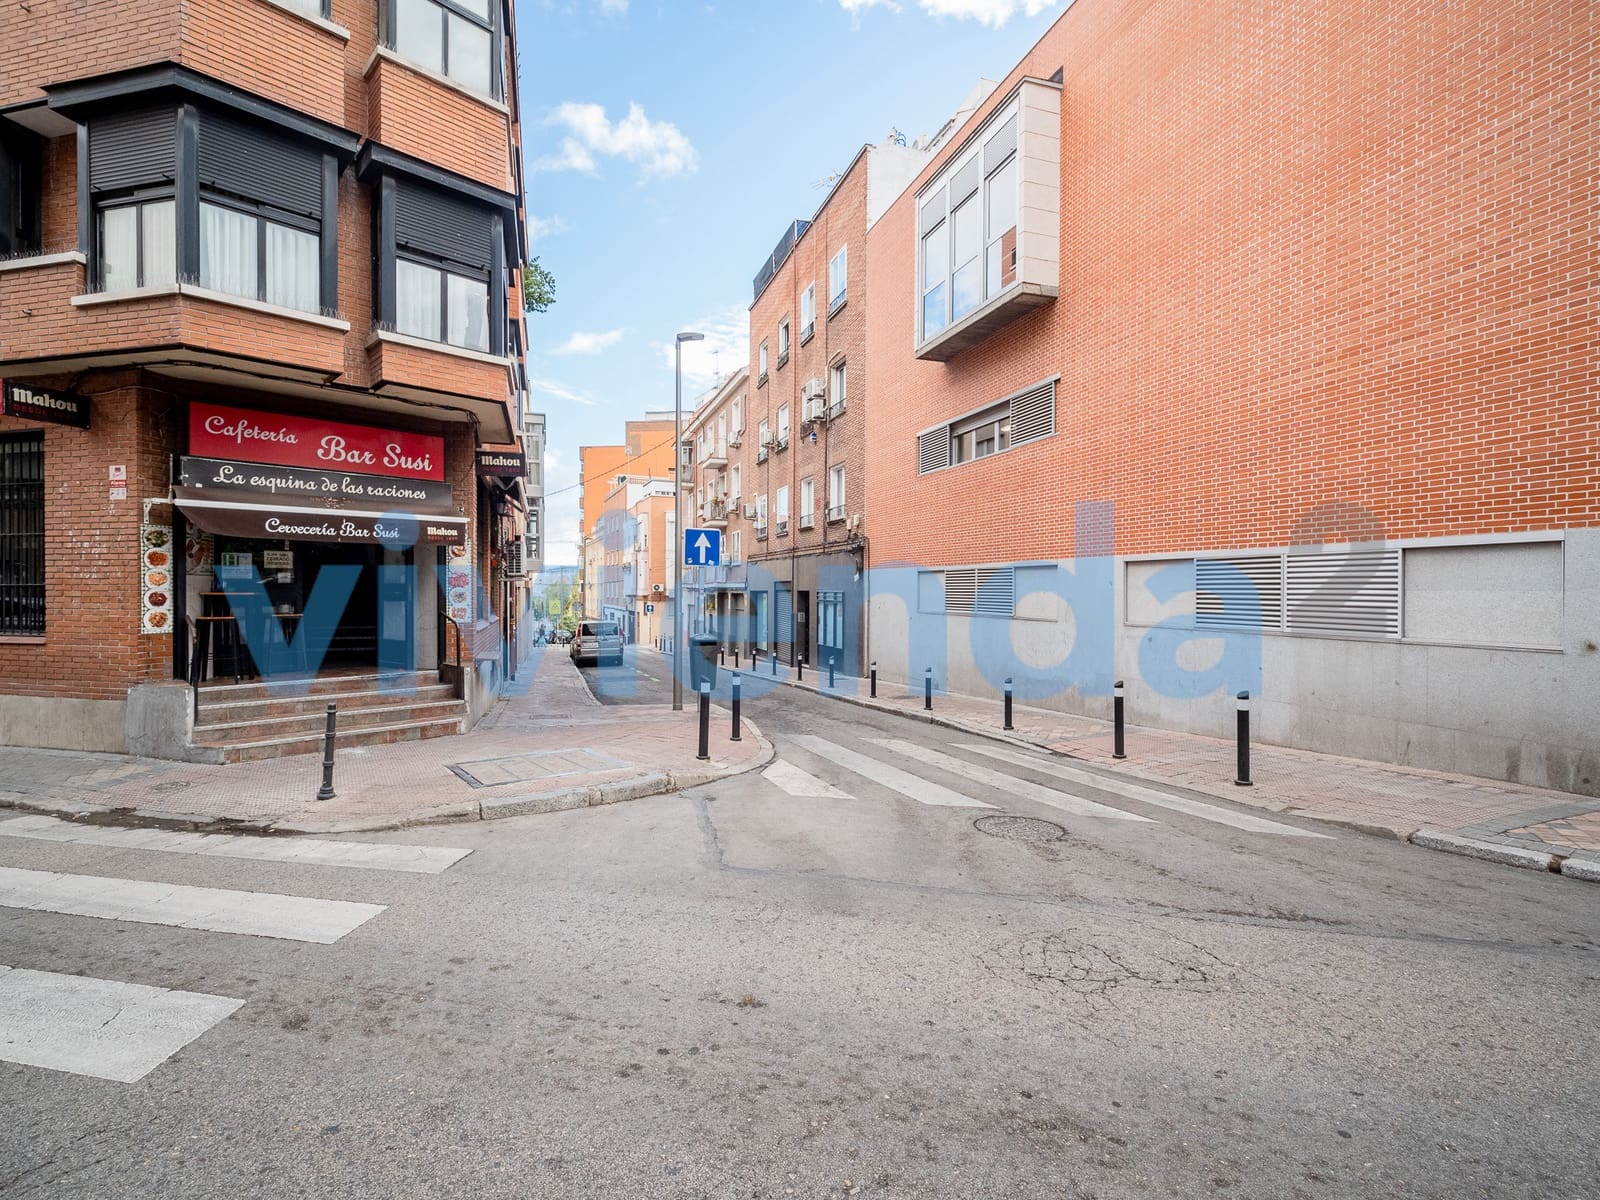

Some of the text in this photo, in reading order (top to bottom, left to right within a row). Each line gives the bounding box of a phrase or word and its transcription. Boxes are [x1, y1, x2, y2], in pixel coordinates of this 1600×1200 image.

[12, 387, 78, 413] Mahou
[204, 415, 433, 471] Cafetería Bar Susi
[480, 455, 520, 467] Mahou
[212, 465, 427, 500] La esquina de las raciones
[264, 518, 401, 538] Cervecería Bar Susi
[426, 526, 459, 536] Mahou
